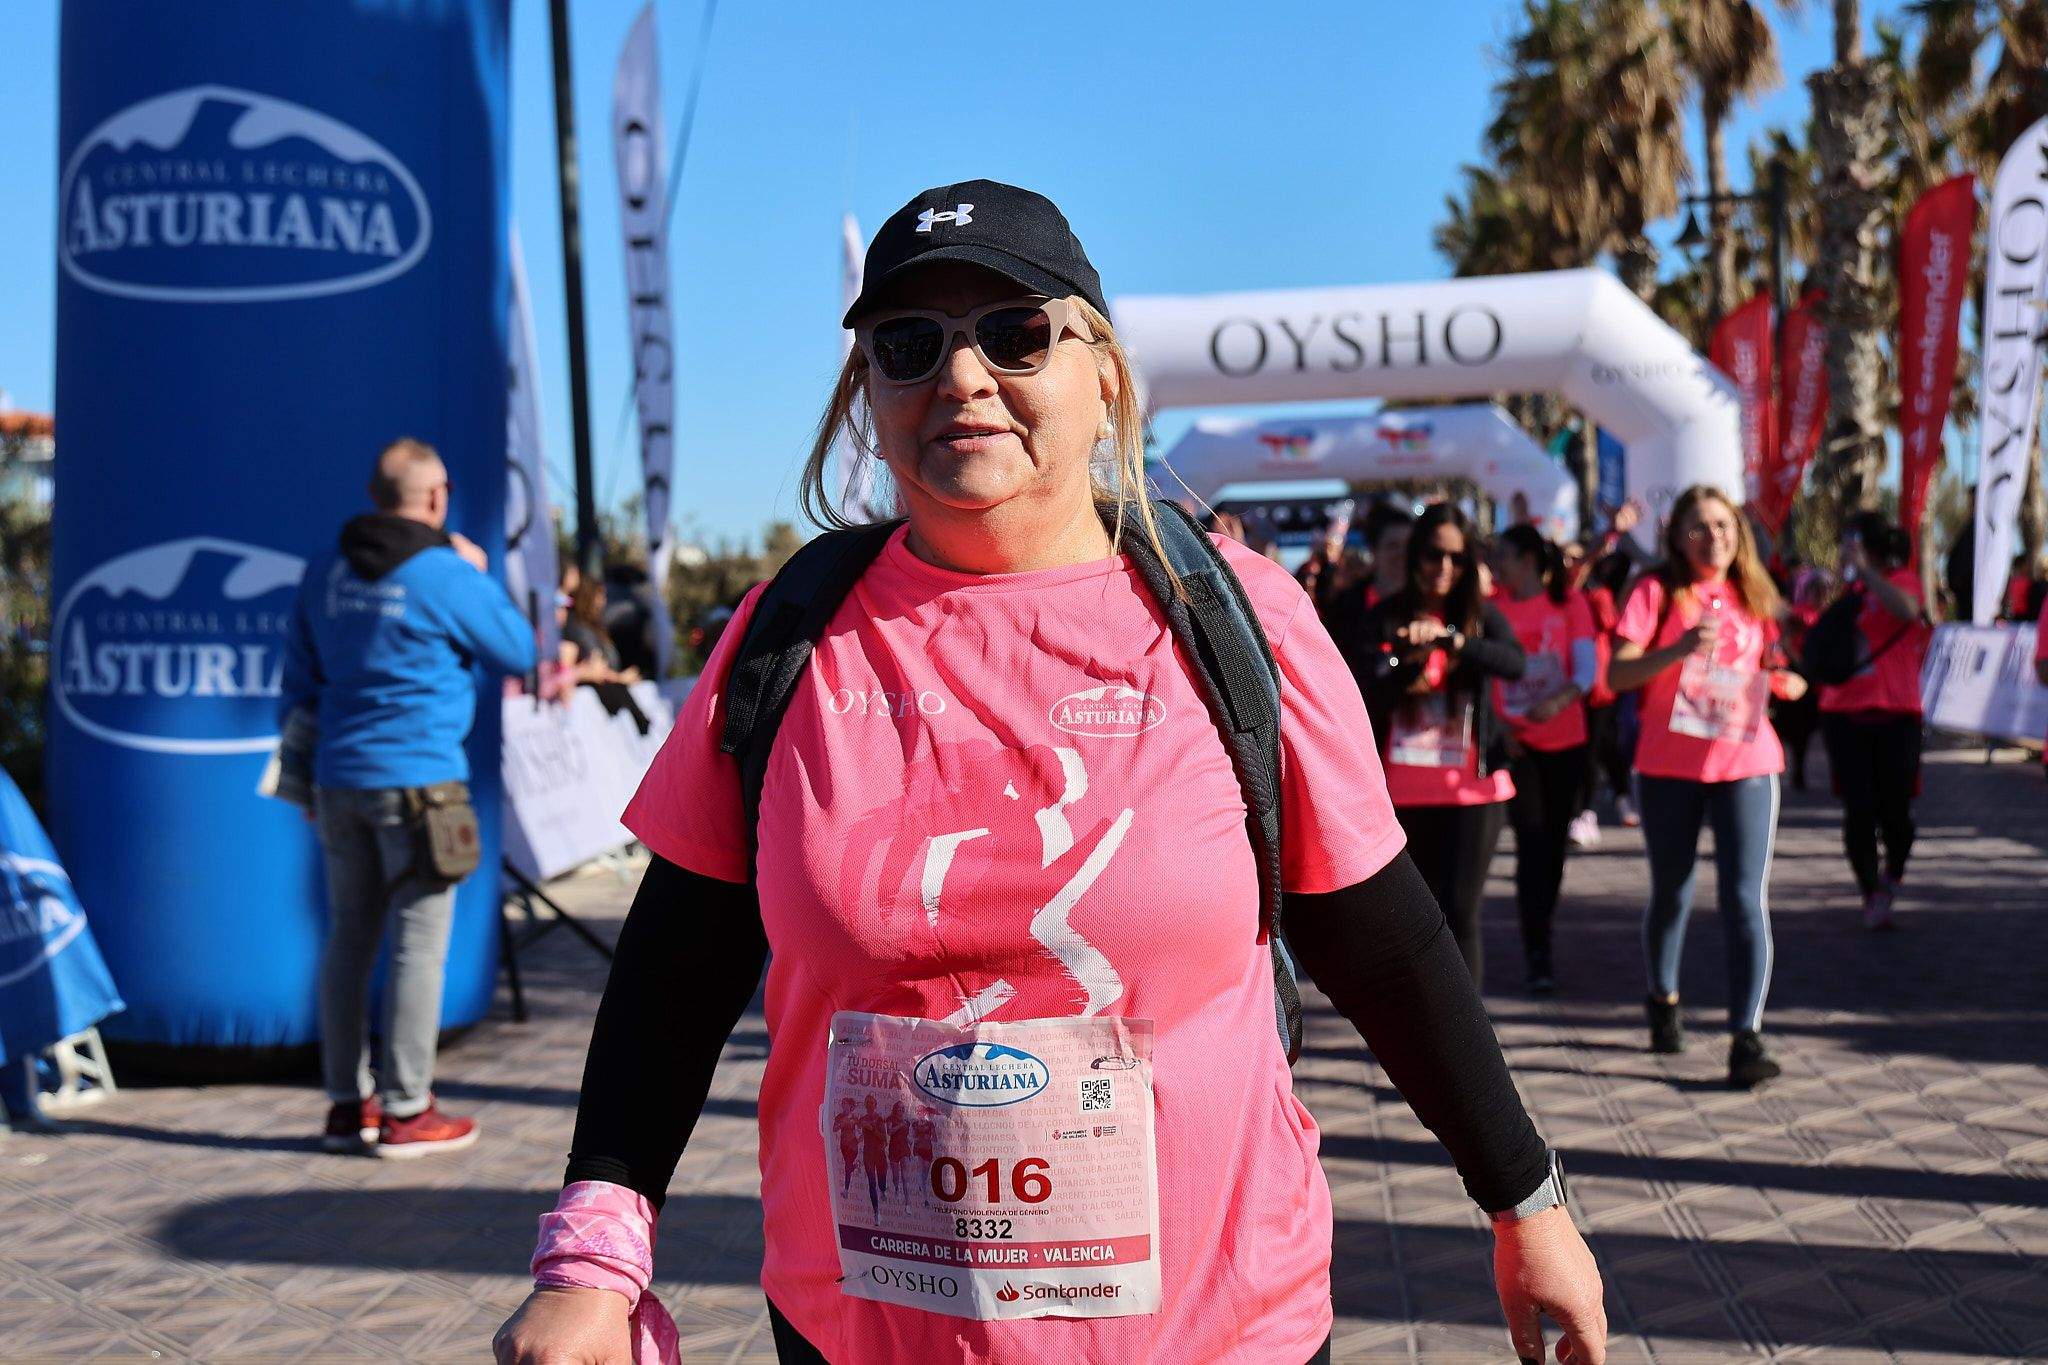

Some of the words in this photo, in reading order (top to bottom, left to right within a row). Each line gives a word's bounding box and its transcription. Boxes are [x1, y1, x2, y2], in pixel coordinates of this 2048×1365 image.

[104, 159, 230, 186] CENTRAL
[244, 159, 390, 193] LECHERA
[72, 174, 403, 256] ASTURIANA
[1914, 232, 1954, 416] Santander
[1208, 304, 1506, 379] OYSHO
[97, 610, 224, 635] CENTRAL
[828, 688, 947, 719] OYSHO
[848, 1068, 901, 1090] SUMA
[923, 1063, 1040, 1091] ASTURIANA
[942, 1063, 986, 1071] CENTRAL
[989, 1063, 1034, 1071] LECHERA
[931, 1156, 1052, 1204] 016
[1020, 1207, 1049, 1216] GÉNERO
[955, 1217, 1013, 1239] 8332
[870, 1235, 930, 1257] CARRERA
[934, 1245, 951, 1260] DE
[956, 1247, 973, 1262] LA
[978, 1249, 1029, 1263] MUJER
[1043, 1245, 1115, 1262] VALENCIA
[871, 1265, 959, 1298] OYSHO
[1023, 1280, 1122, 1300] Santander
